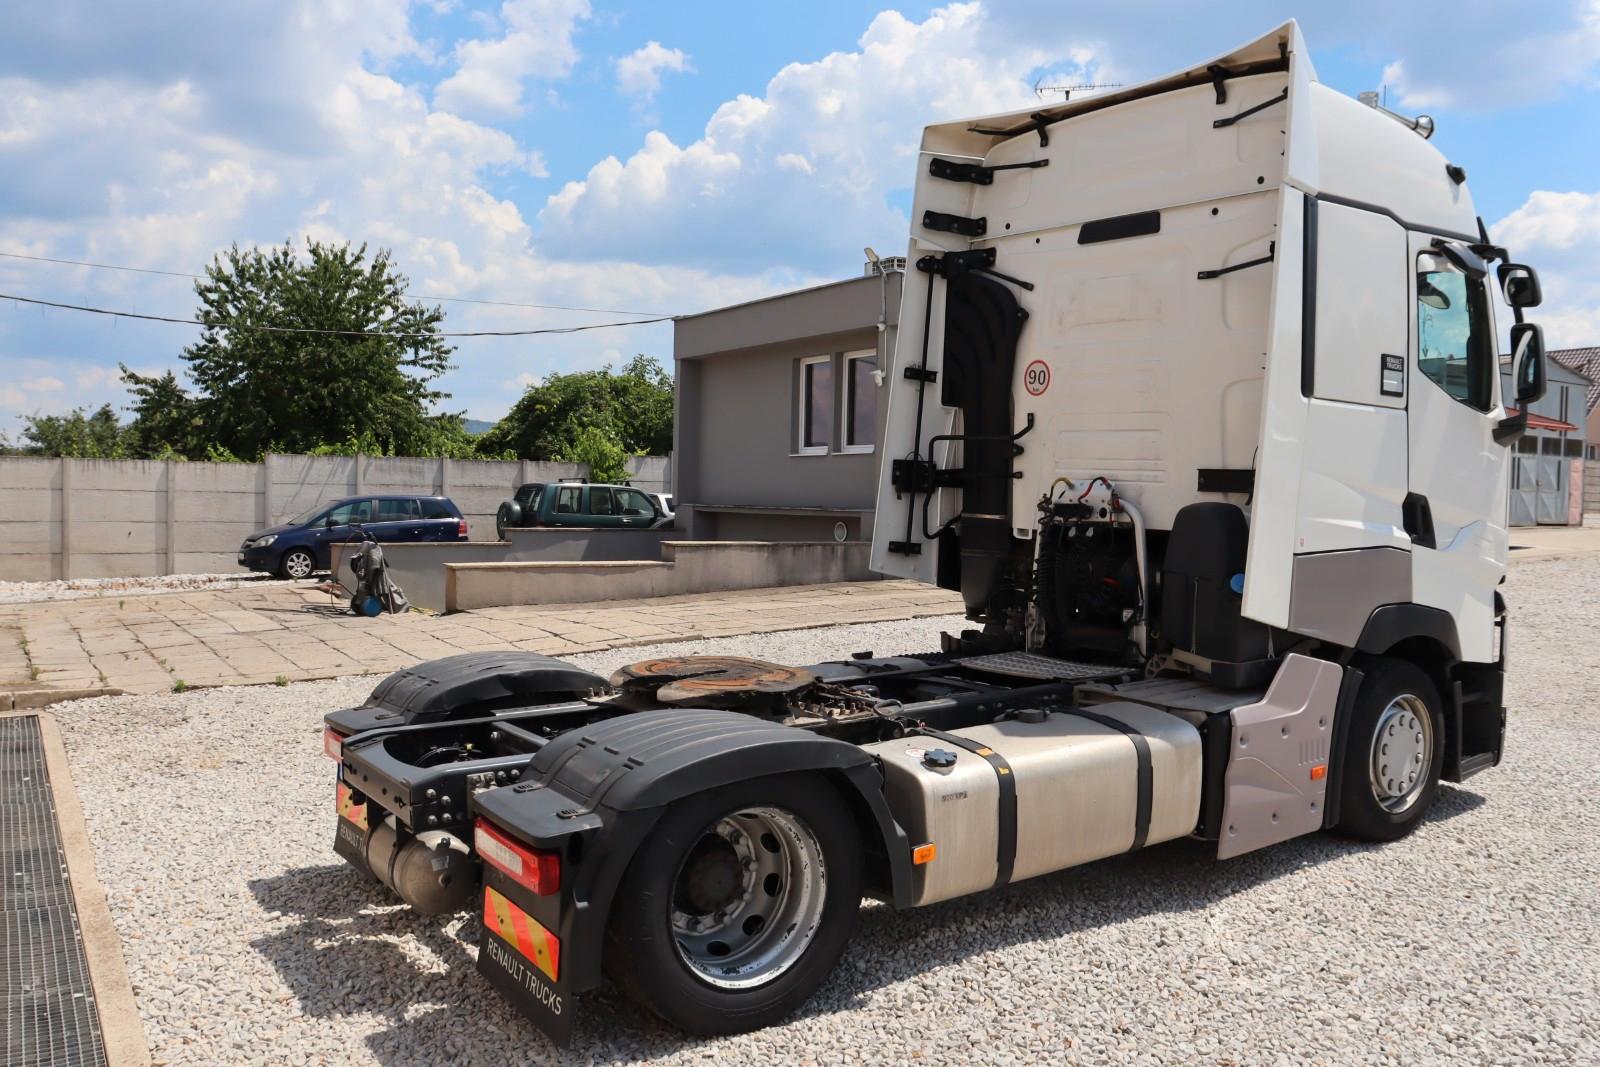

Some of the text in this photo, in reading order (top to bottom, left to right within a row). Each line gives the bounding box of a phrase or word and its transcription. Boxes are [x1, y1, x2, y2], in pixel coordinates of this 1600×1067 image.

[1028, 369, 1046, 386] 90
[487, 937, 562, 1015] RENAULT TRUCKS
